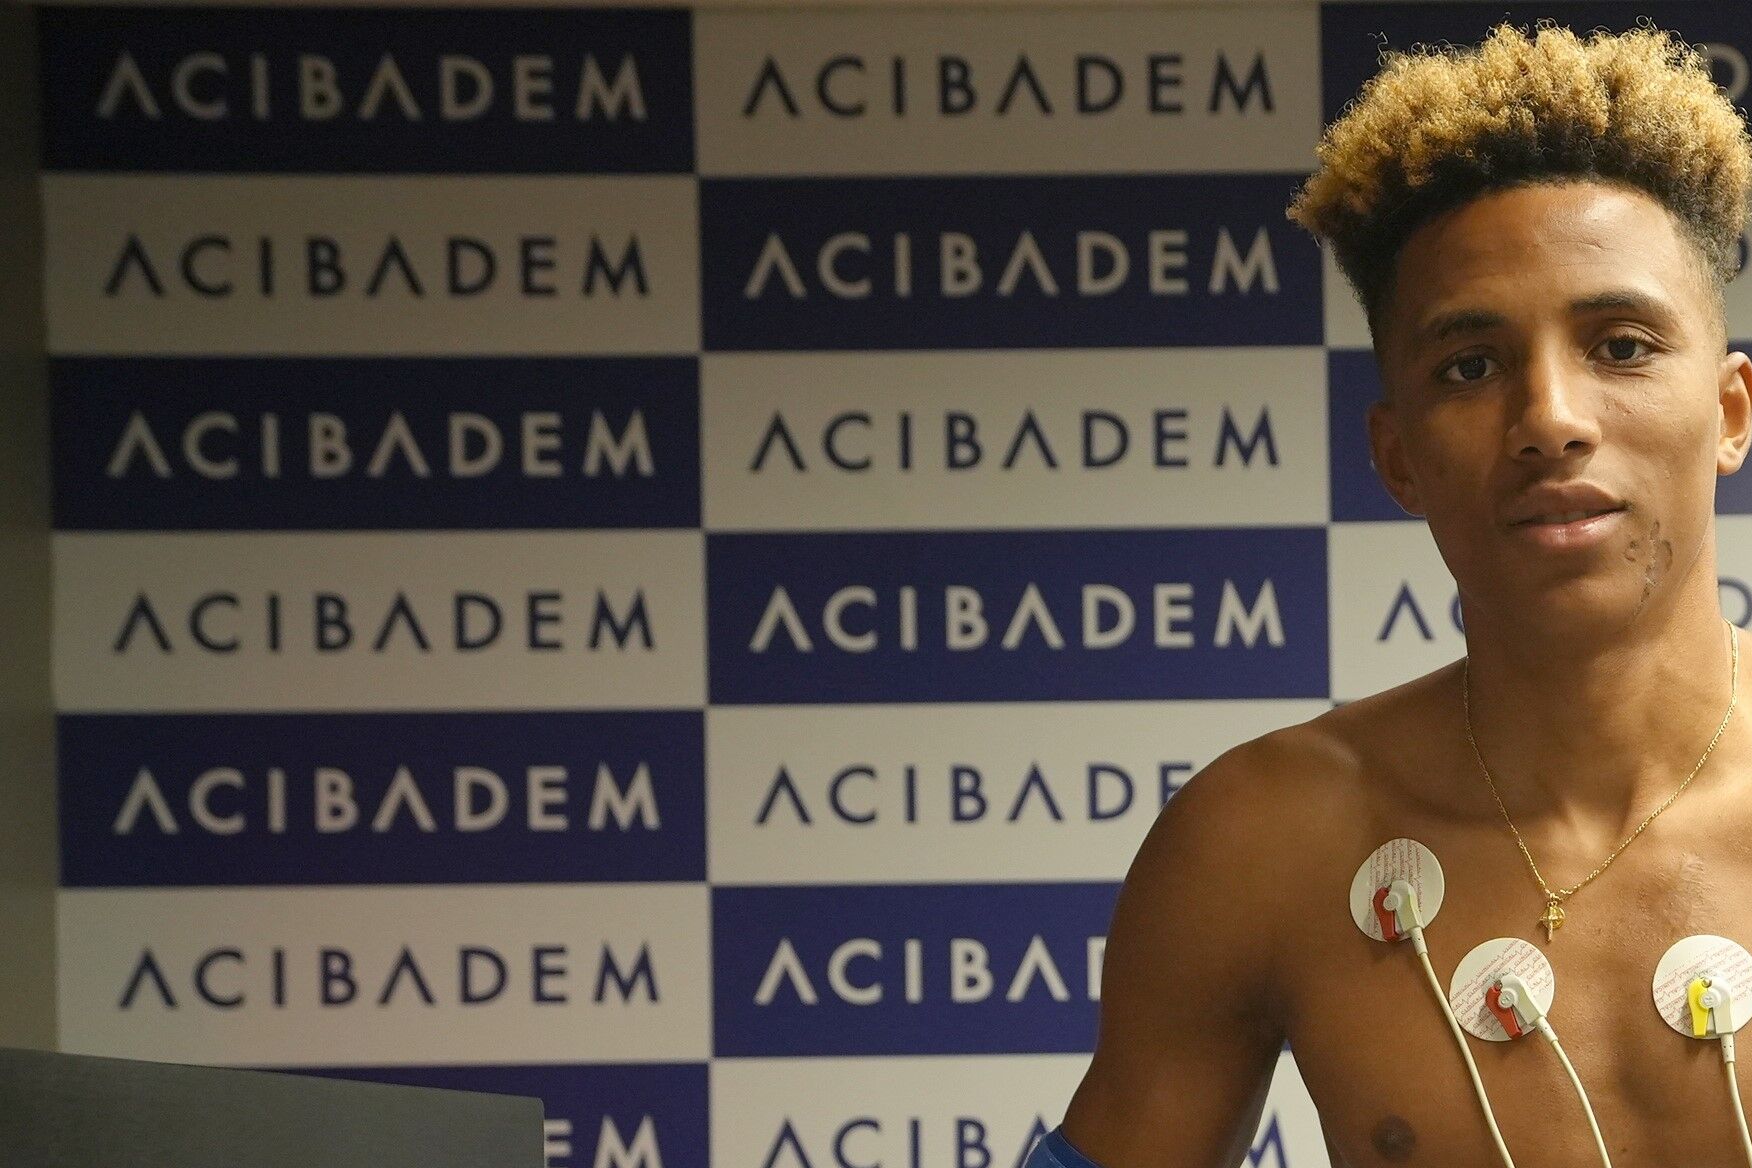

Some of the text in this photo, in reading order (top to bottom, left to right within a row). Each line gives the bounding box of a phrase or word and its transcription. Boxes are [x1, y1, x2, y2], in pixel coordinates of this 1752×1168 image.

[98, 53, 647, 122] ACIBADEM
[742, 52, 1276, 119] ACIBADEM
[104, 234, 651, 299] ACIBADEM
[745, 228, 1280, 299] ACIBADEM
[108, 411, 655, 479] ACIBADEM
[749, 407, 1281, 474] ACIBADEM
[113, 590, 656, 655] ACIBADEM
[750, 580, 1286, 653] ACIBADEM
[115, 764, 661, 835] ACIBADEM
[756, 762, 1193, 826] ACIBADE
[118, 943, 661, 1010] ACIBADEM
[755, 935, 1107, 1006] ACIBA
